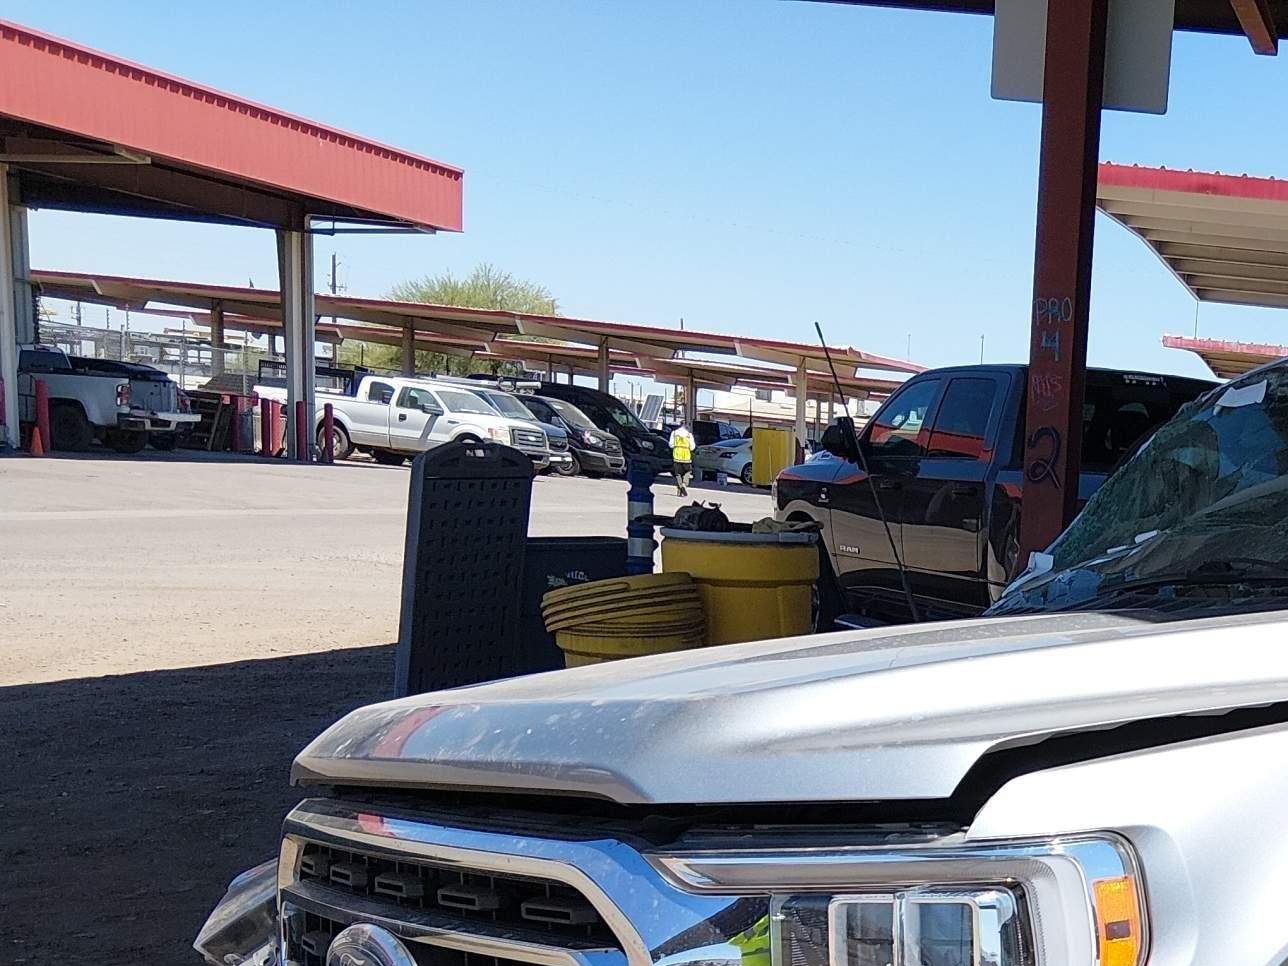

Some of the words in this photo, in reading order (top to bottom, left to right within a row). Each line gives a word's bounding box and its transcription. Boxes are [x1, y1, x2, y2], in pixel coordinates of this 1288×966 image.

[1040, 329, 1061, 362] 4
[1027, 426, 1062, 490] 2
[840, 545, 859, 553] RAM
